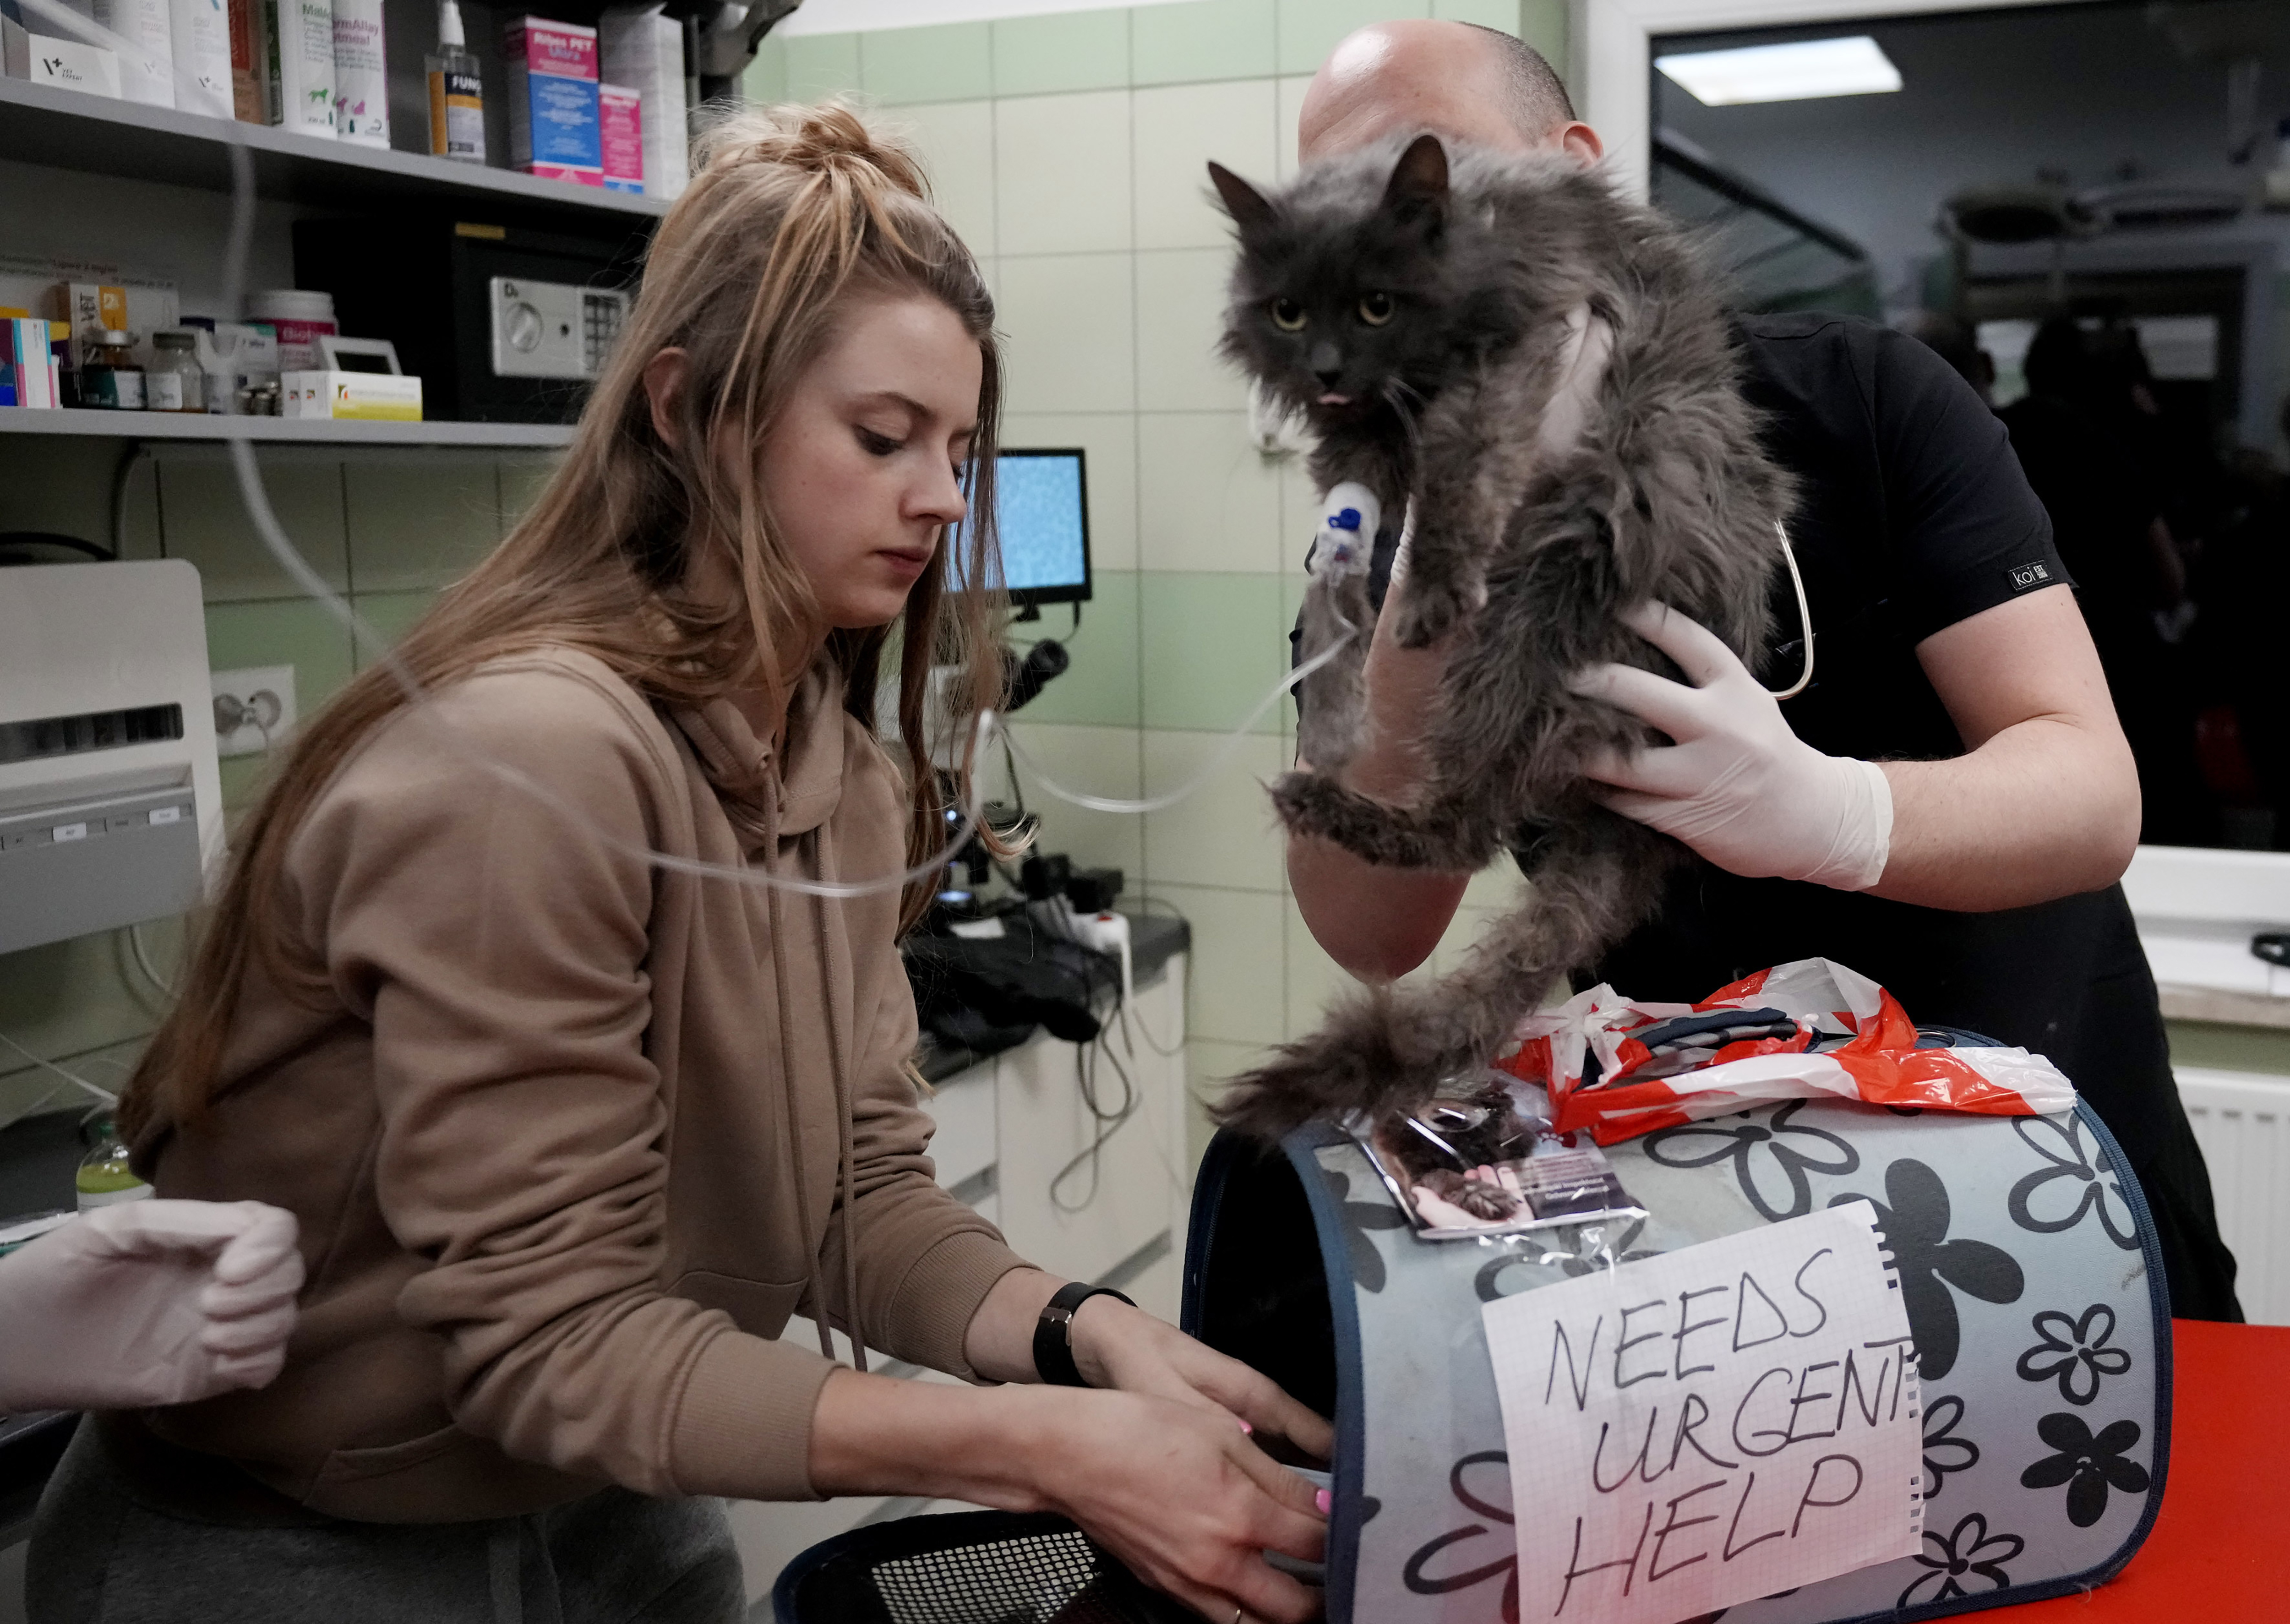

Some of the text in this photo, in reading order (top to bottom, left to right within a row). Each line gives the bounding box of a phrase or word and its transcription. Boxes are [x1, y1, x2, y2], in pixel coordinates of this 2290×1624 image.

[2012, 567, 2036, 586] koi
[1545, 1248, 1832, 1411] NEEDS
[1592, 1336, 1913, 1493] URGENT
[1554, 1454, 1863, 1617] HELP
